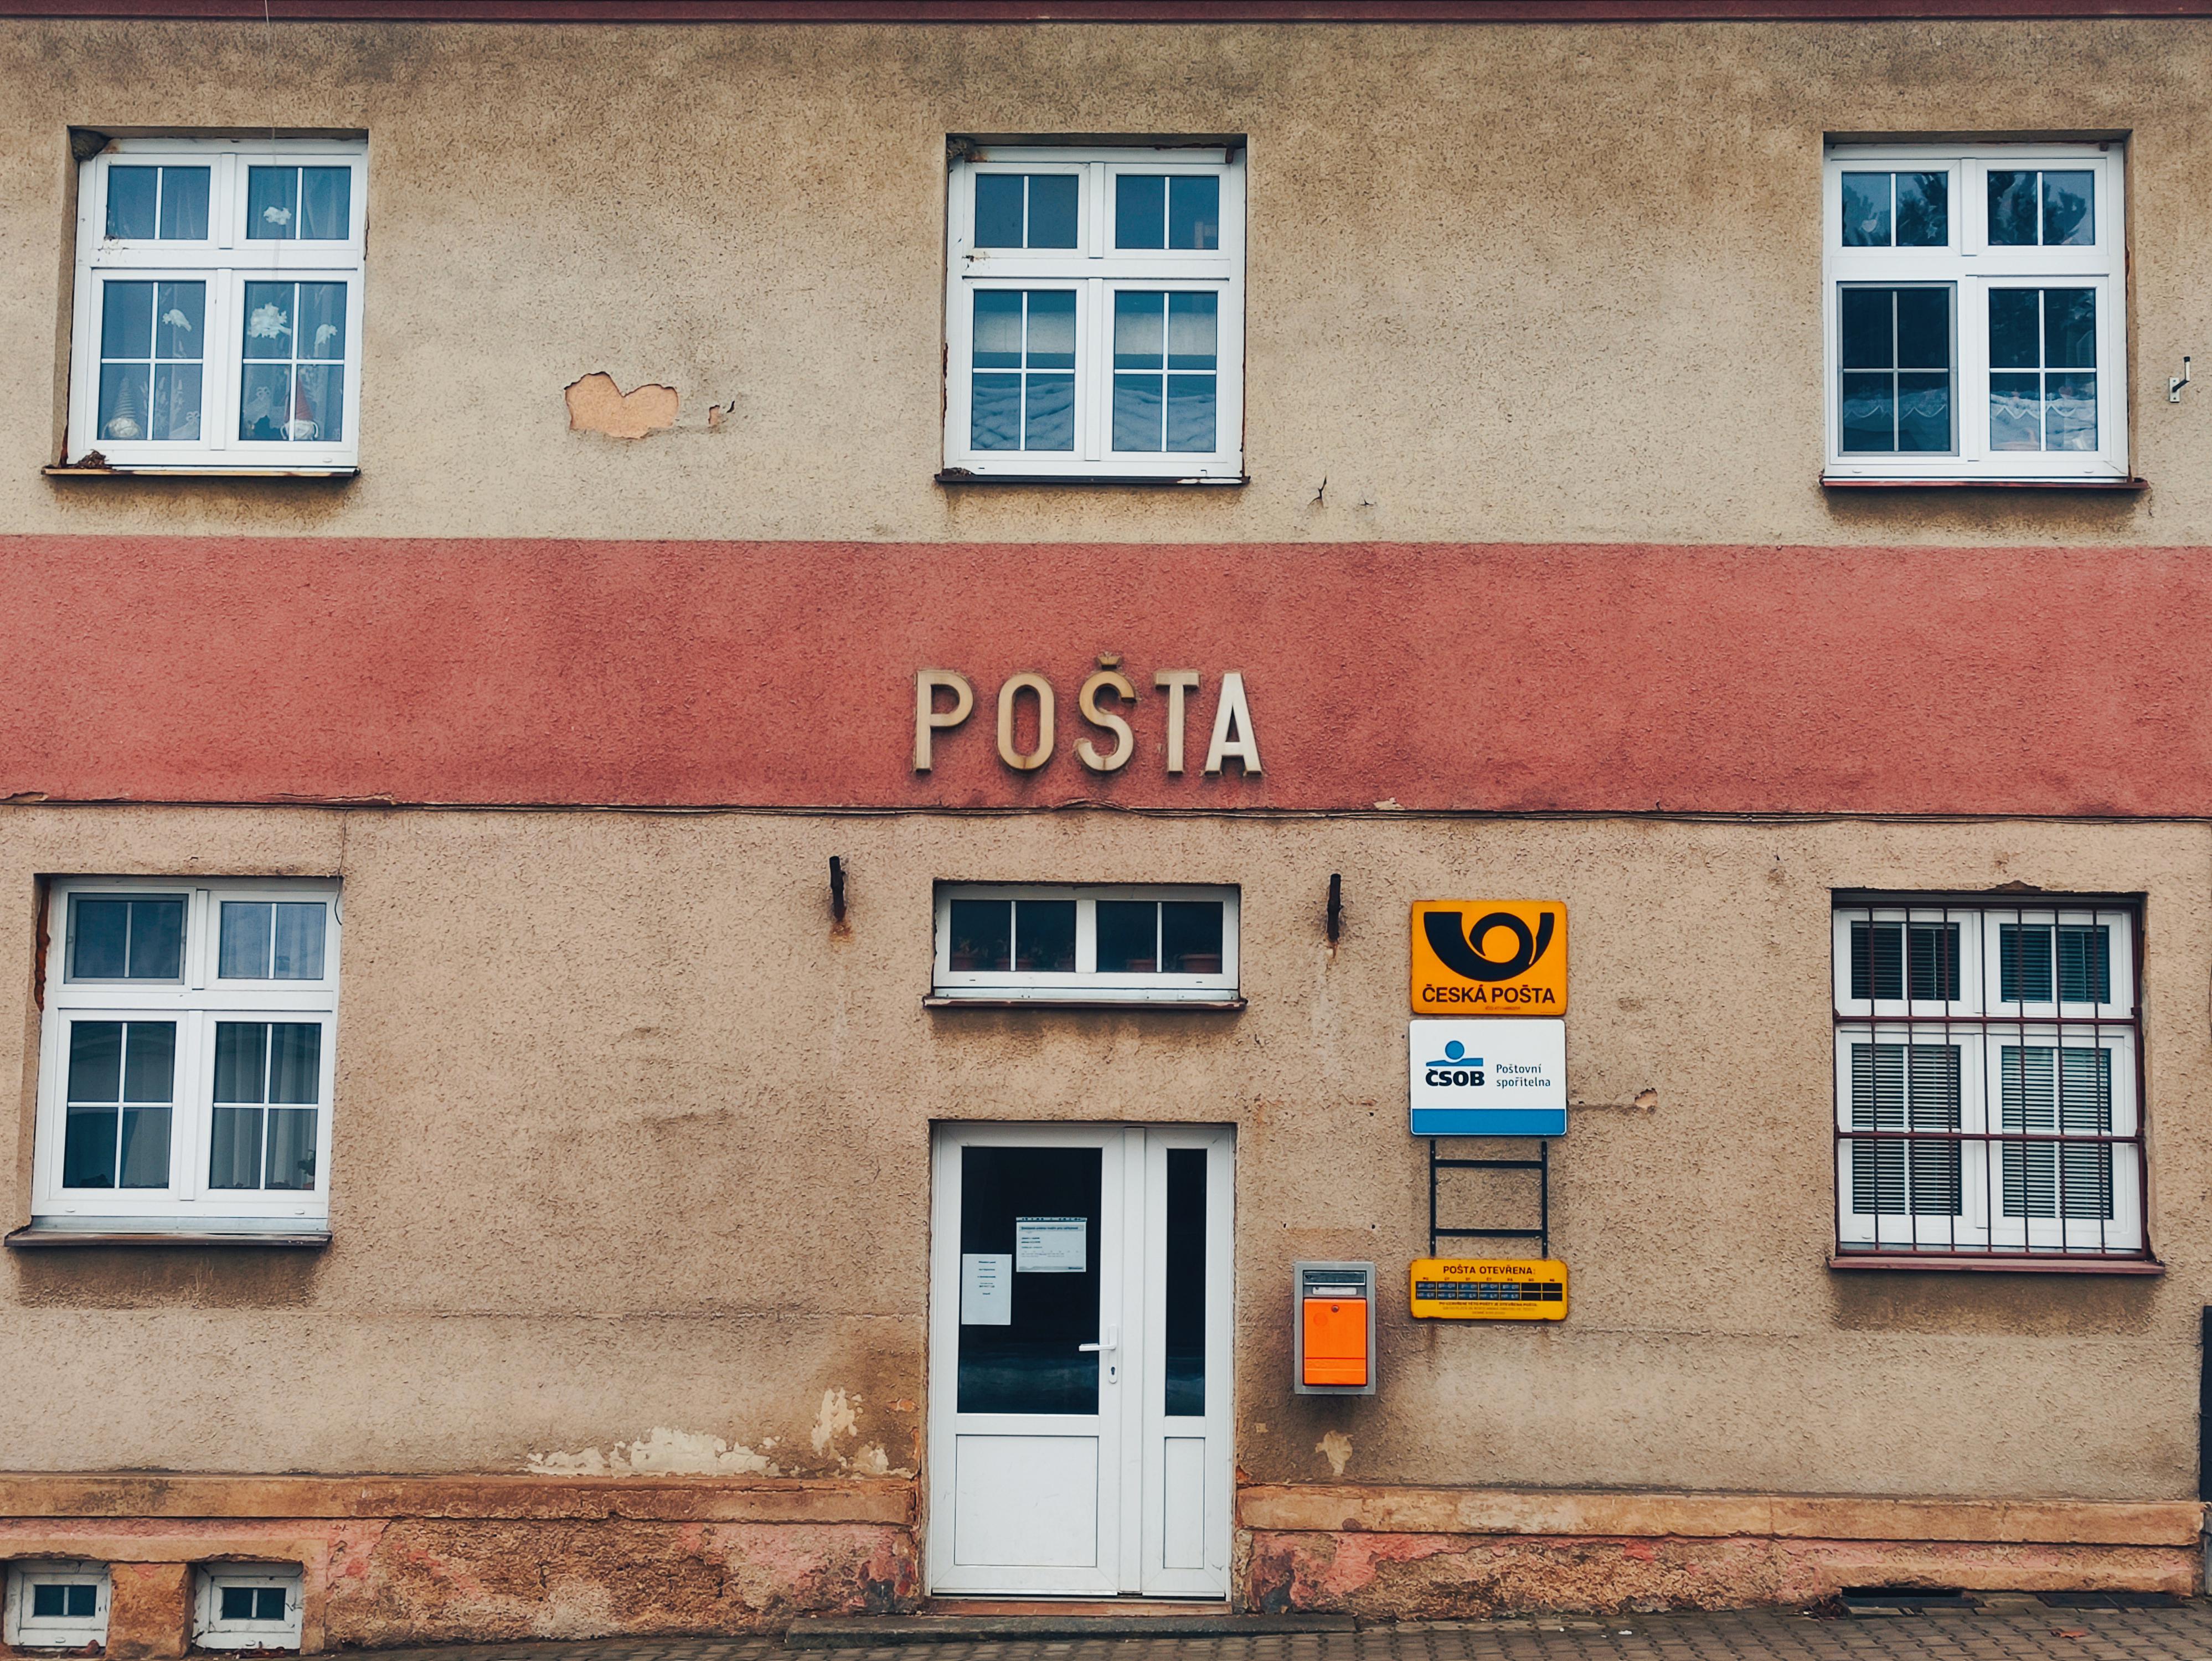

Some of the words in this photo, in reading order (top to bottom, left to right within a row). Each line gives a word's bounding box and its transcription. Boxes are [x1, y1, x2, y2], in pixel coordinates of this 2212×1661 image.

[914, 651, 1265, 776] POŠTA
[1422, 984, 1487, 1003] ČESKÁ
[1492, 984, 1555, 1003] POŠTA
[1496, 1063, 1541, 1074] Poštovní
[1425, 1069, 1485, 1086] ČSOB
[1496, 1077, 1551, 1089] spořitelna
[1443, 1264, 1476, 1274] POŠTA
